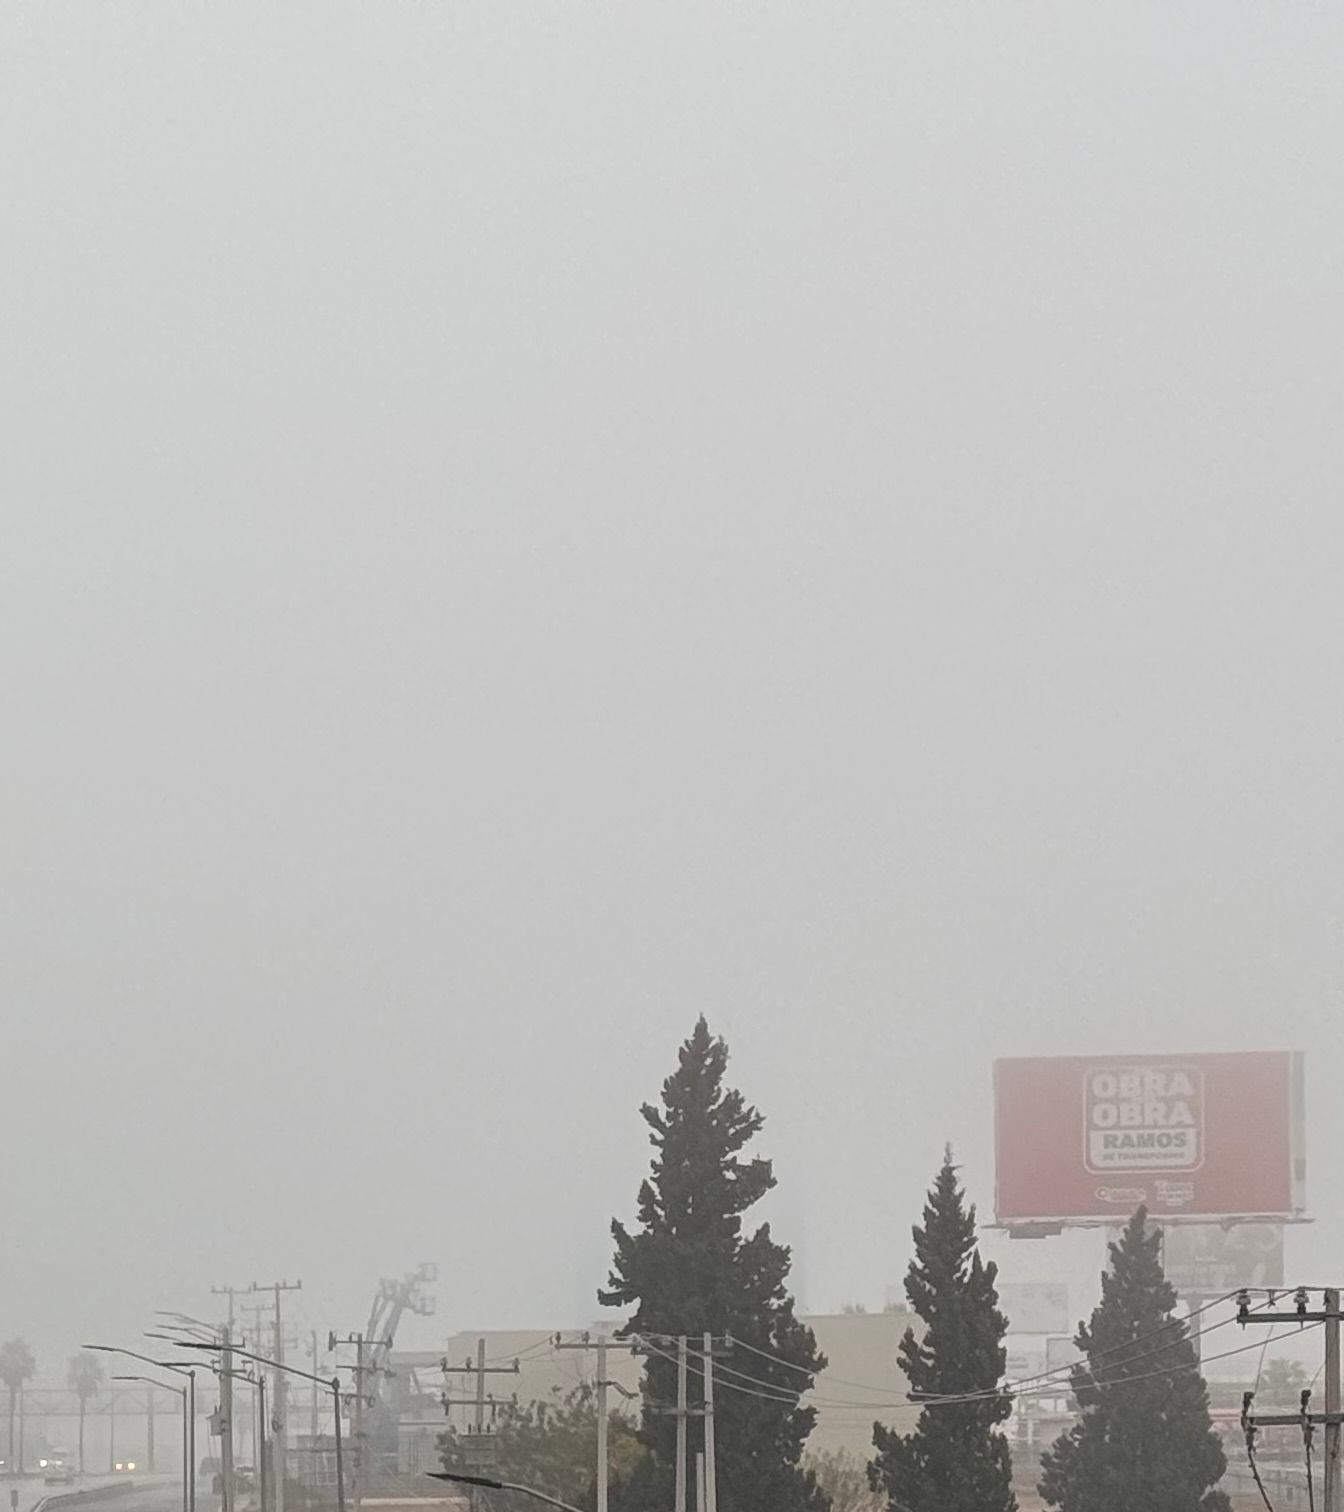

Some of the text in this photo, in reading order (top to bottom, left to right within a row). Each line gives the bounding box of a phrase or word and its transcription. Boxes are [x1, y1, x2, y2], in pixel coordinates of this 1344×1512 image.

[1092, 1071, 1194, 1098] OBRA
[1092, 1100, 1195, 1127] OBRA
[1103, 1131, 1186, 1149] RAMOS
